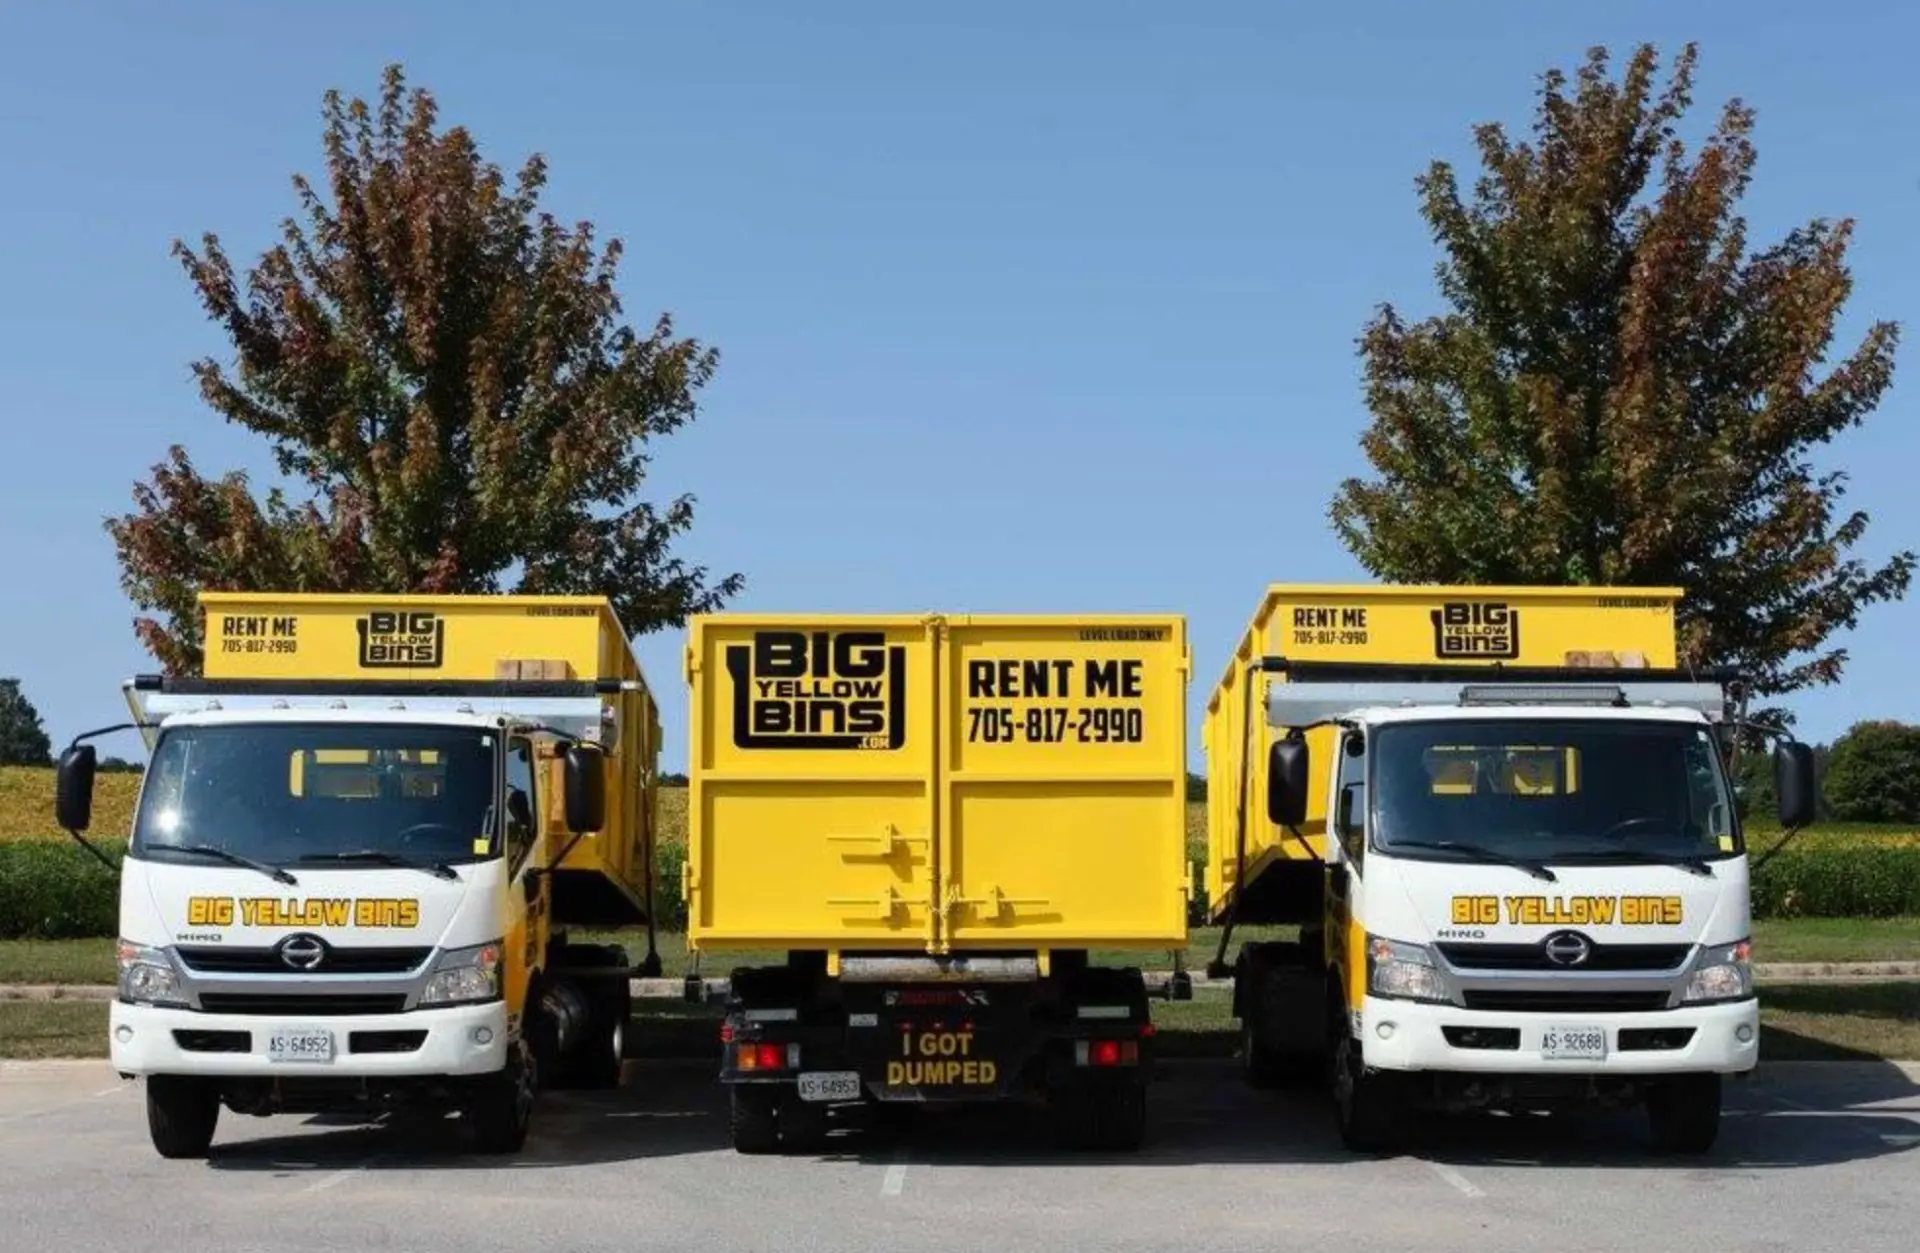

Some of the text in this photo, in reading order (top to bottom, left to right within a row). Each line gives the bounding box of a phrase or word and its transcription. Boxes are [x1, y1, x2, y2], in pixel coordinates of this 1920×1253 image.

[370, 612, 435, 634] BIG
[1294, 608, 1367, 627] RENT ME
[1444, 603, 1508, 625] BIG
[223, 616, 297, 636] RENT ME
[1445, 626, 1507, 635] YELLOW
[370, 635, 433, 644] YELLOW
[1444, 636, 1509, 650] BINS
[369, 645, 433, 660] BINS
[755, 632, 885, 678] BIG
[757, 681, 882, 698] YELLOW
[969, 660, 1143, 697] RENT ME
[754, 701, 885, 732] BINS
[968, 708, 1142, 743] 705-817-2990
[188, 897, 419, 927] BIG YELLOW BINS
[1452, 896, 1682, 925] BIG YELLOW BINS
[177, 933, 222, 942] HINO
[1437, 930, 1485, 939] HINO
[903, 1032, 973, 1056] I GOT
[887, 1061, 996, 1085] DUMPED
